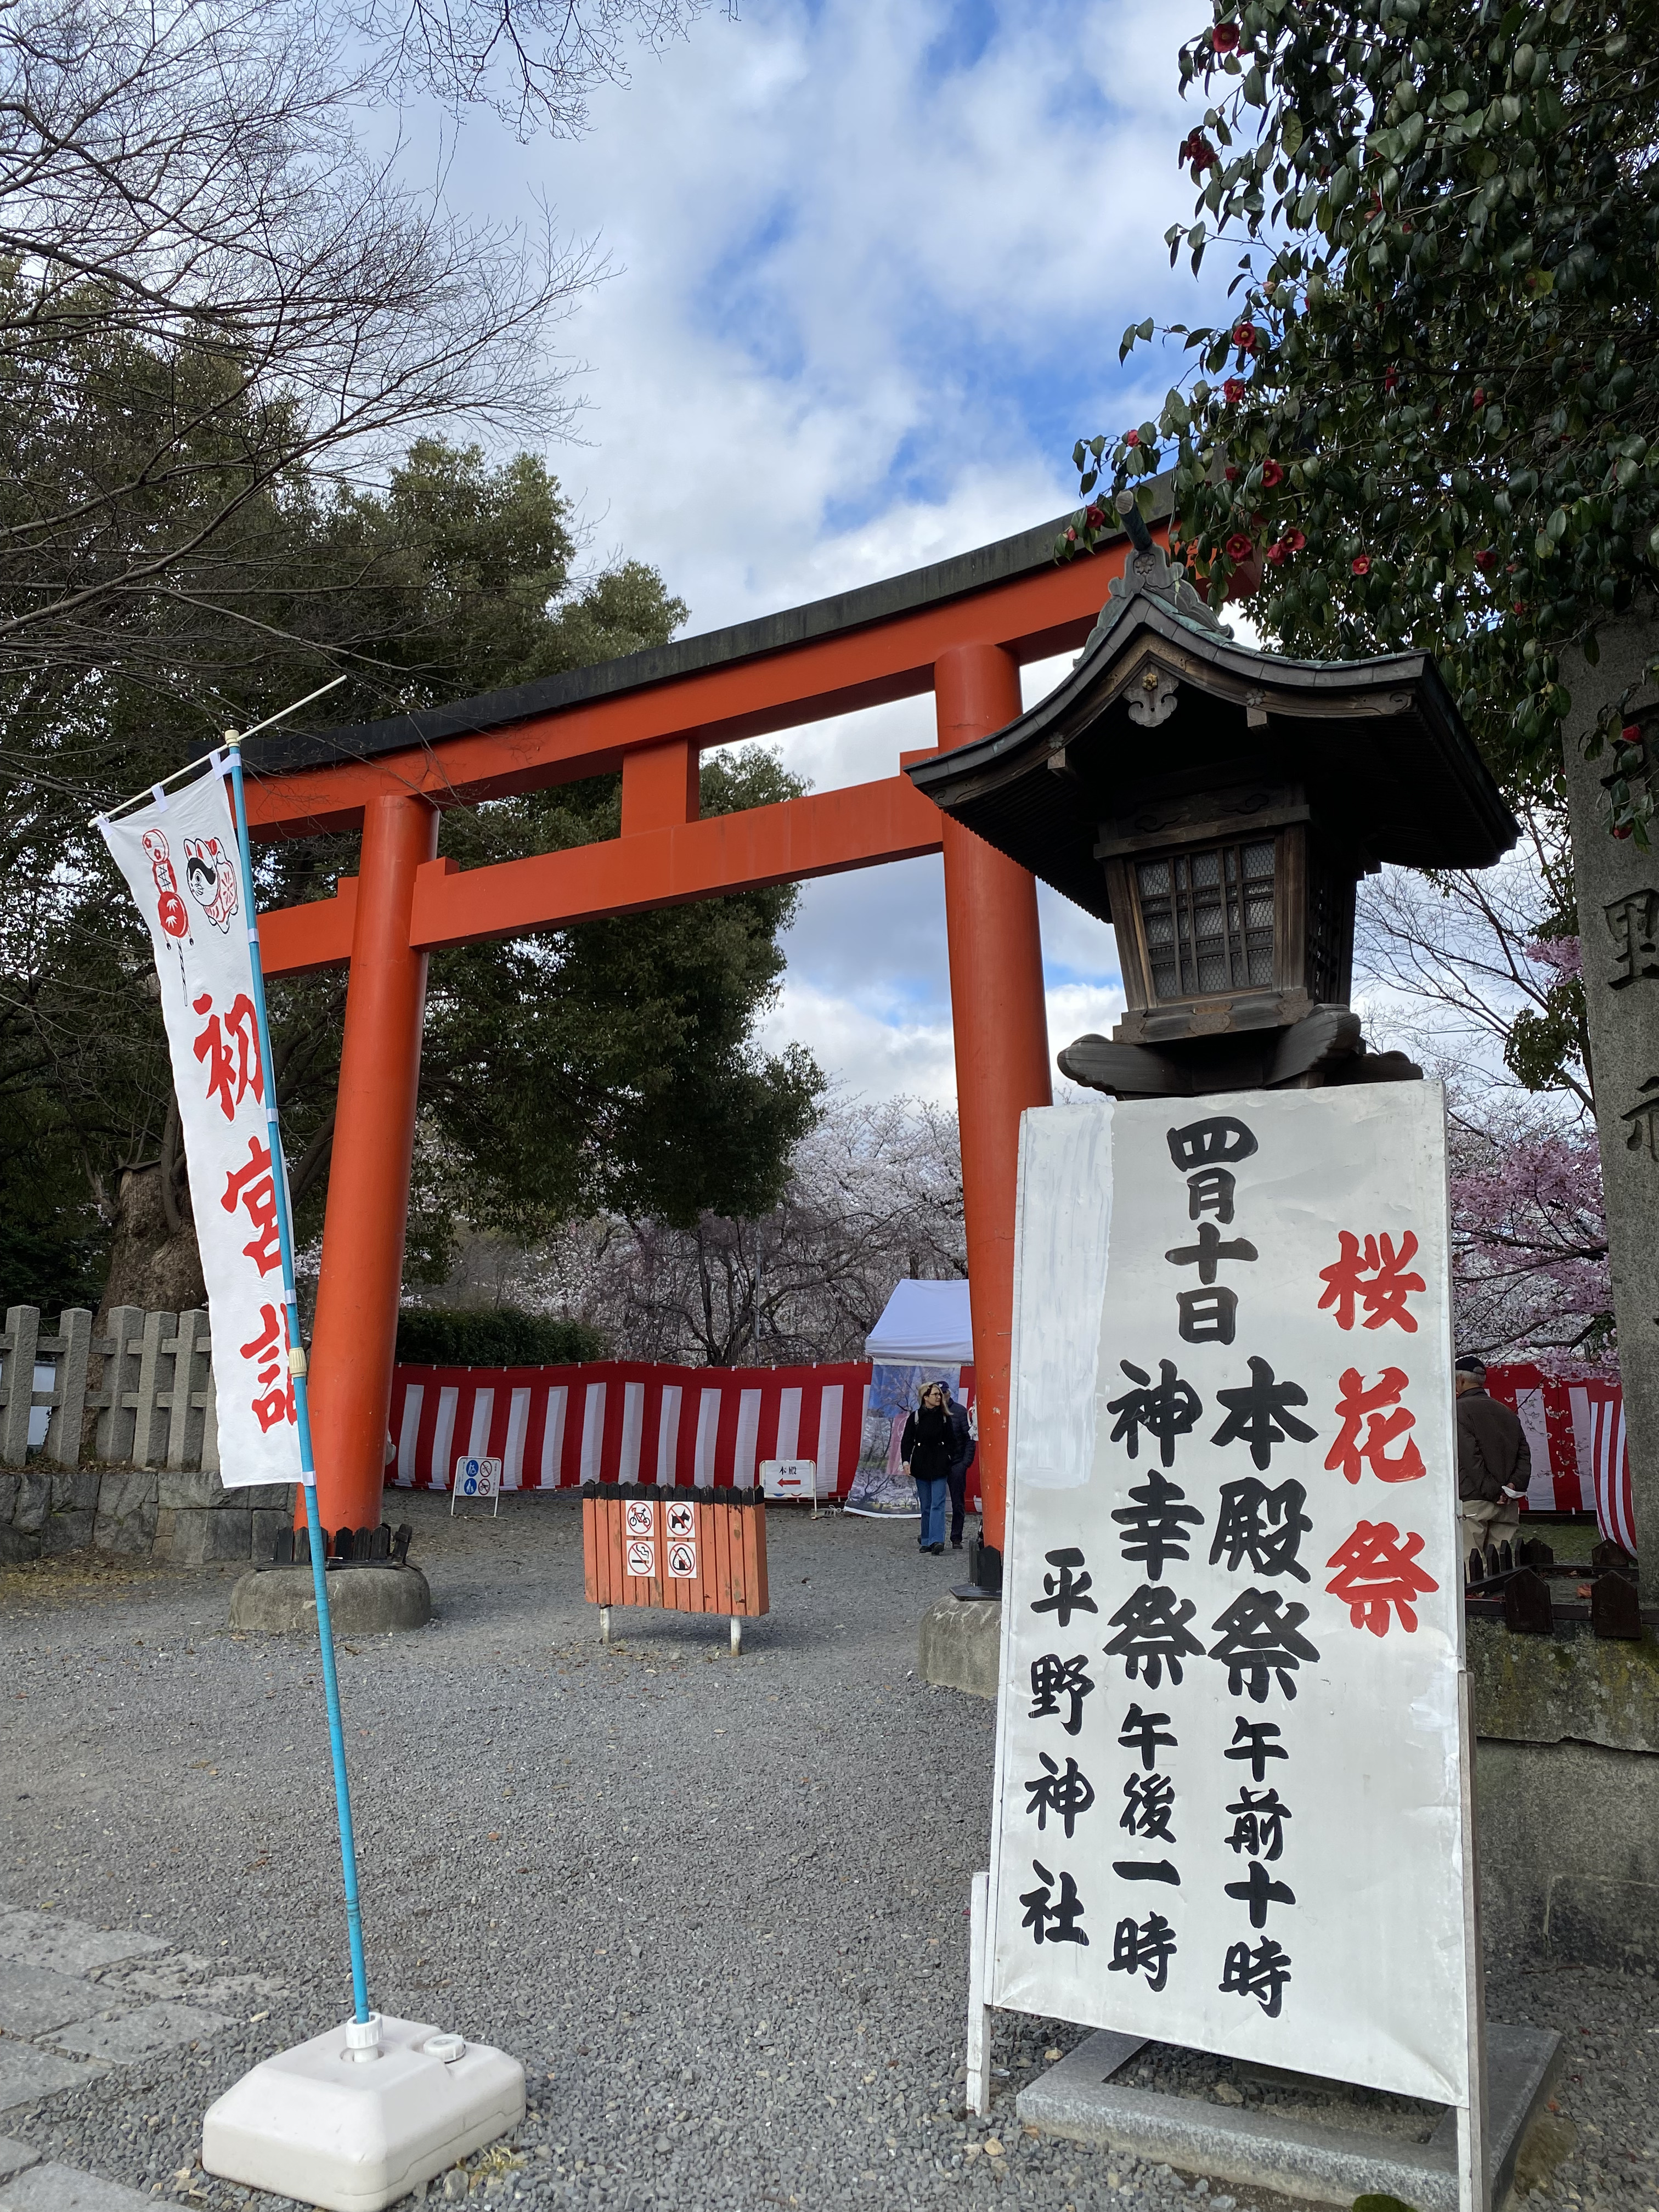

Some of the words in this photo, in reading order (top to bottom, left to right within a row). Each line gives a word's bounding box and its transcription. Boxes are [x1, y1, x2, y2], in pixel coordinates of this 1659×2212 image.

[1165, 1116, 1259, 1345] 四月十日
[1317, 1231, 1439, 1638] 桜花祭
[1019, 1548, 1098, 1948] 平野神社
